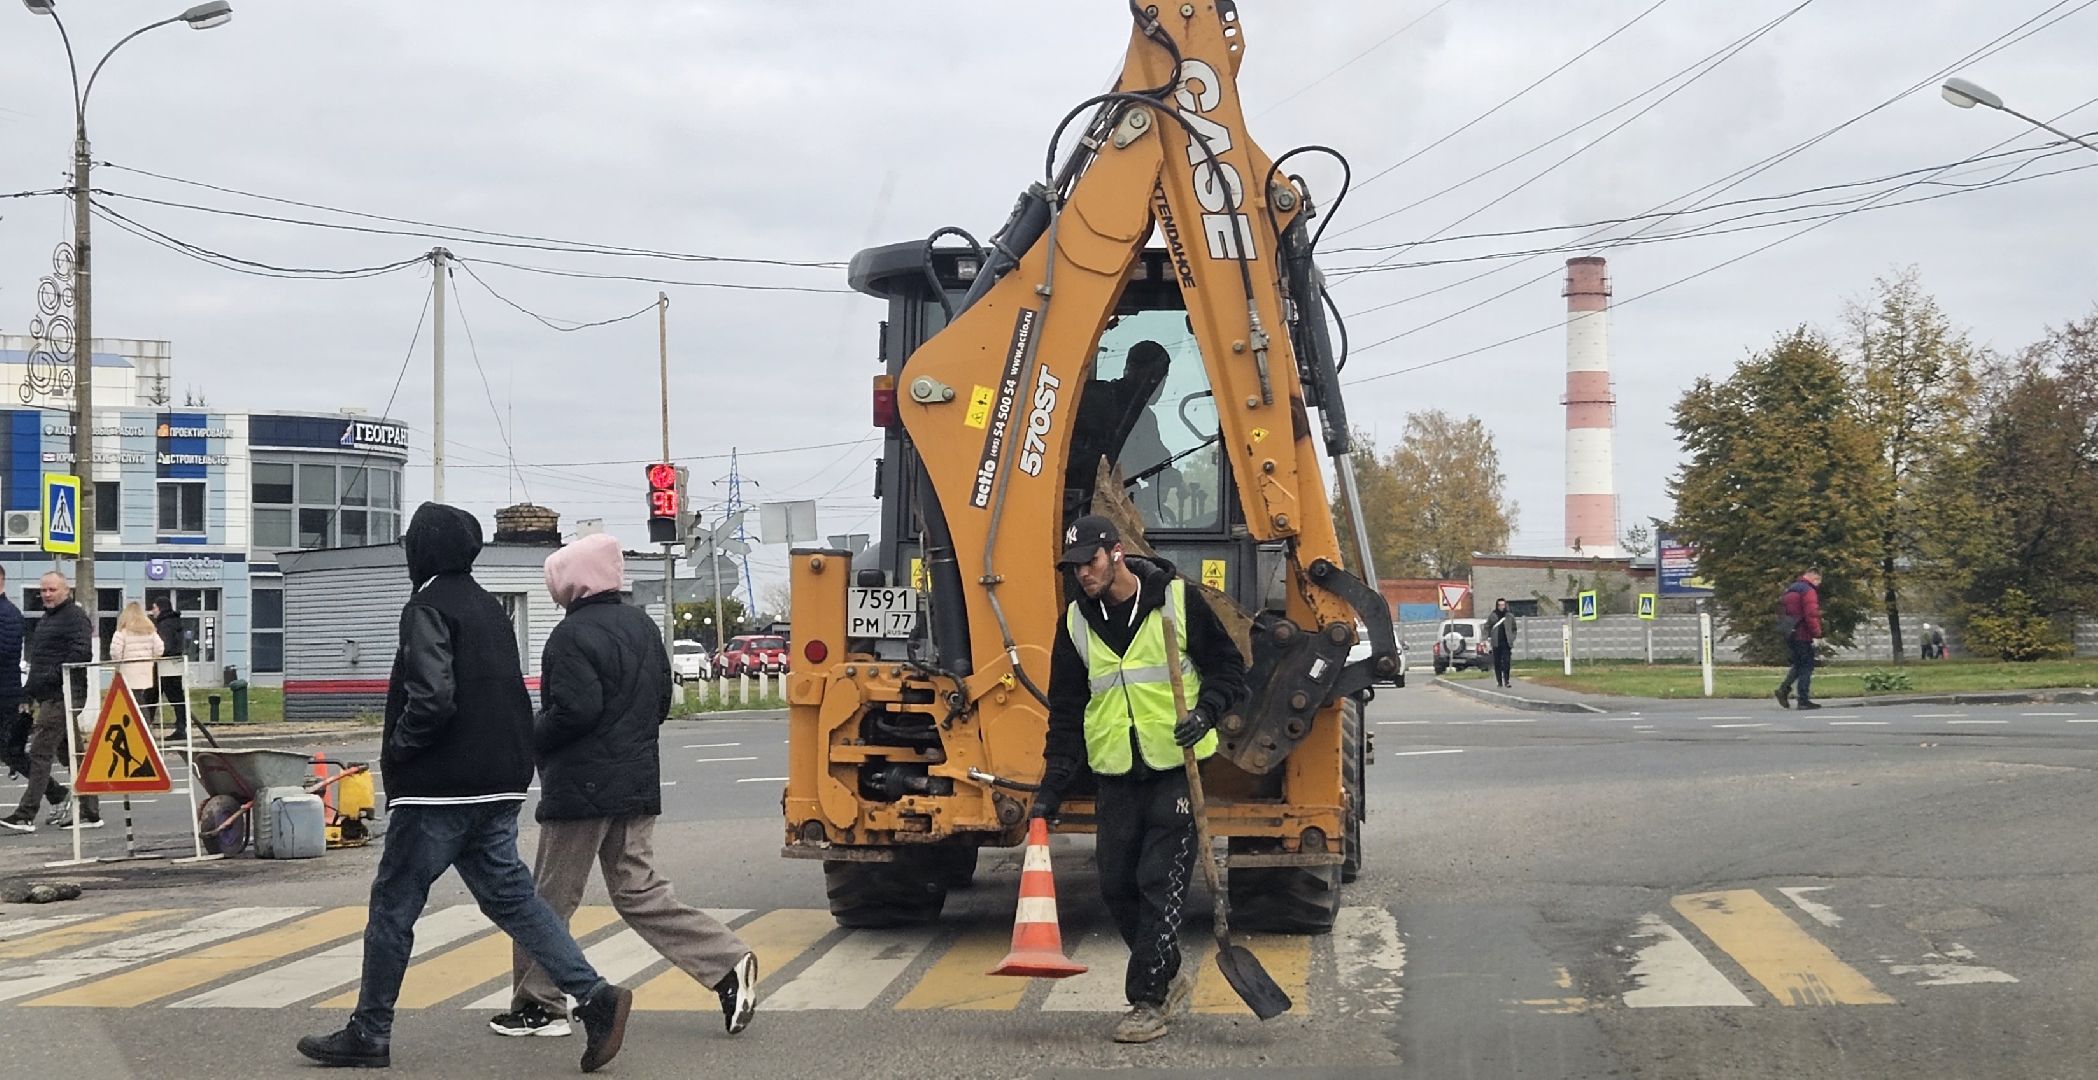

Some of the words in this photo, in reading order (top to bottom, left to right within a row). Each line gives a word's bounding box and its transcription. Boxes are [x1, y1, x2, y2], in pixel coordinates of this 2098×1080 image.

[1172, 58, 1257, 260] CASE
[1153, 176, 1196, 288] XTENDAHOE
[1010, 311, 1033, 375] www.actio.ru
[1003, 379, 1017, 396] 54
[998, 396, 1012, 420] 500
[993, 421, 1006, 437] 54
[1018, 363, 1060, 477] 570ST
[169, 427, 234, 438] ПРОЕКТИРОВАНИЕ
[170, 454, 230, 465] СТРОИТЕЛЬСТВО
[975, 460, 996, 507] actio
[652, 491, 678, 515] 90
[856, 590, 907, 609] 7591
[892, 613, 911, 629] 77
[1176, 797, 1189, 814] NY
